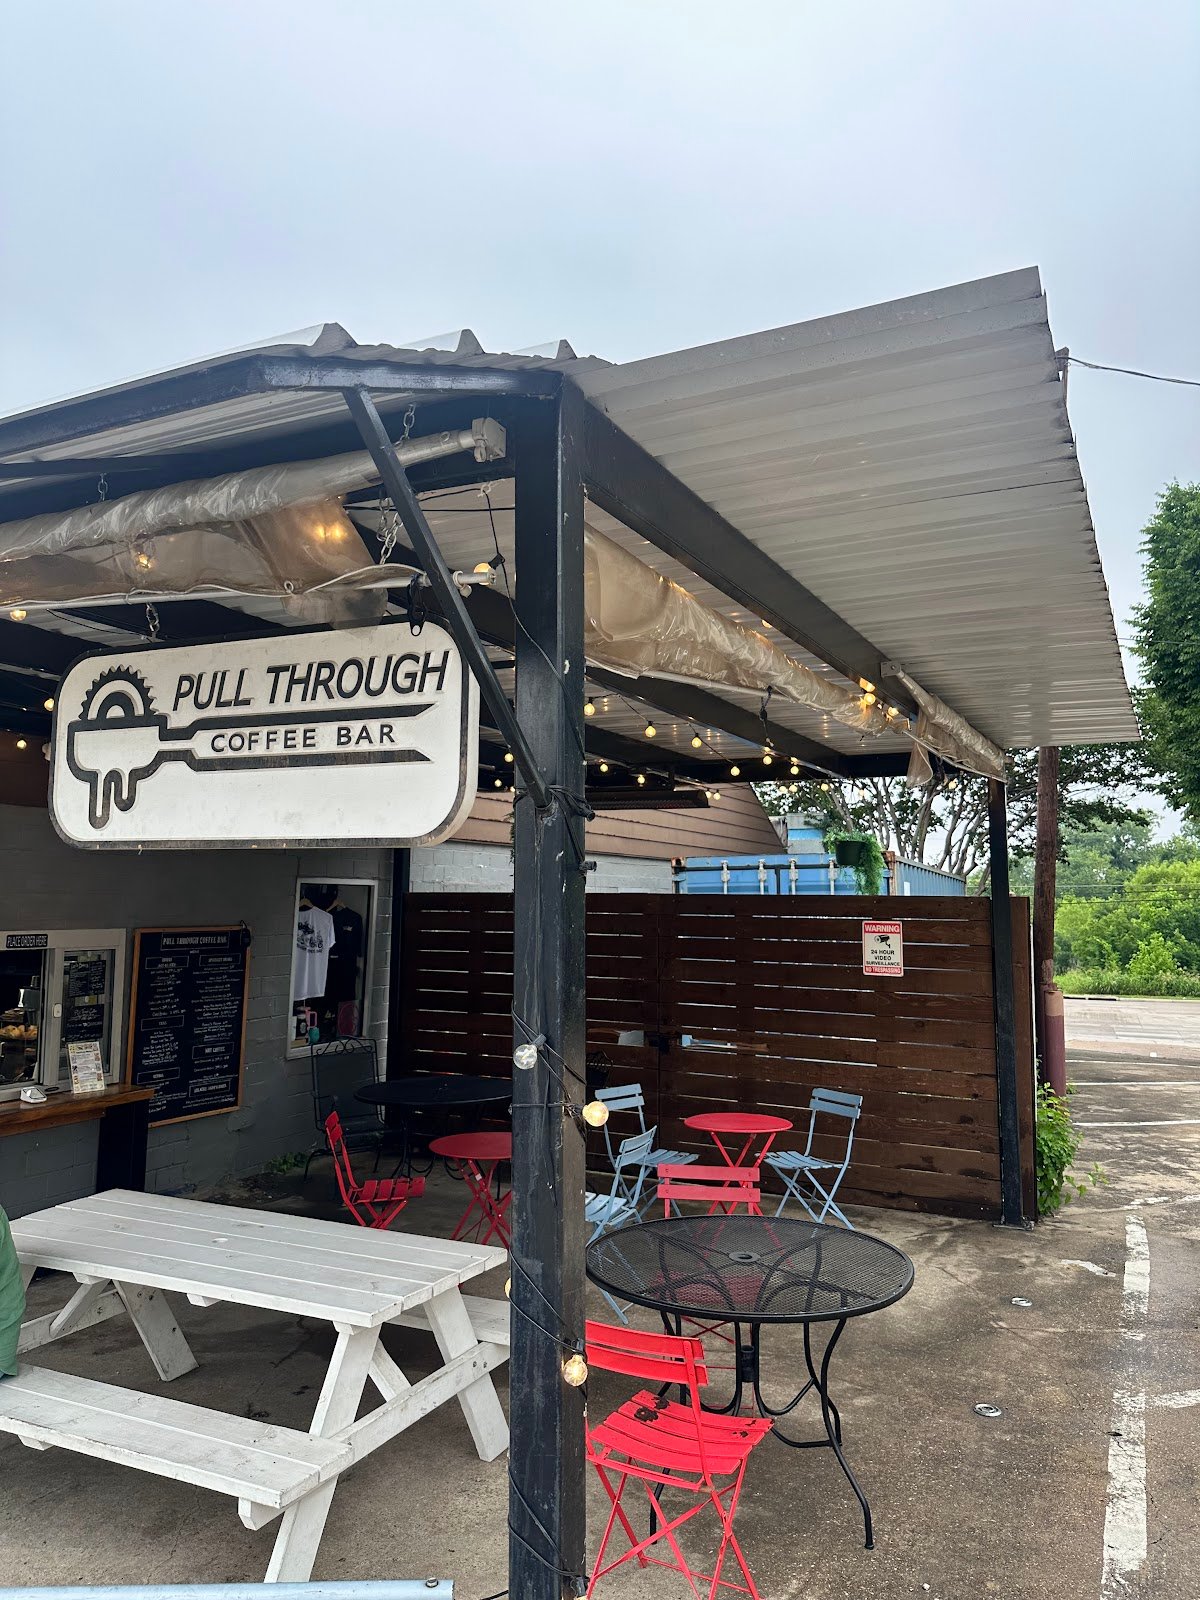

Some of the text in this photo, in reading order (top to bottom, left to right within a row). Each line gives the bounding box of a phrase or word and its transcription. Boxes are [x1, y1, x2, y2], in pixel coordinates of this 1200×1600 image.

[172, 650, 450, 712] PULL THROUGH
[210, 723, 396, 753] COFFEE BAR
[864, 924, 900, 933] WARNING
[7, 935, 48, 947] PLACE ORDER HERE
[162, 936, 227, 945] PULL THROUGH COFFEE BAR
[872, 966, 901, 974] TRESPASSING
